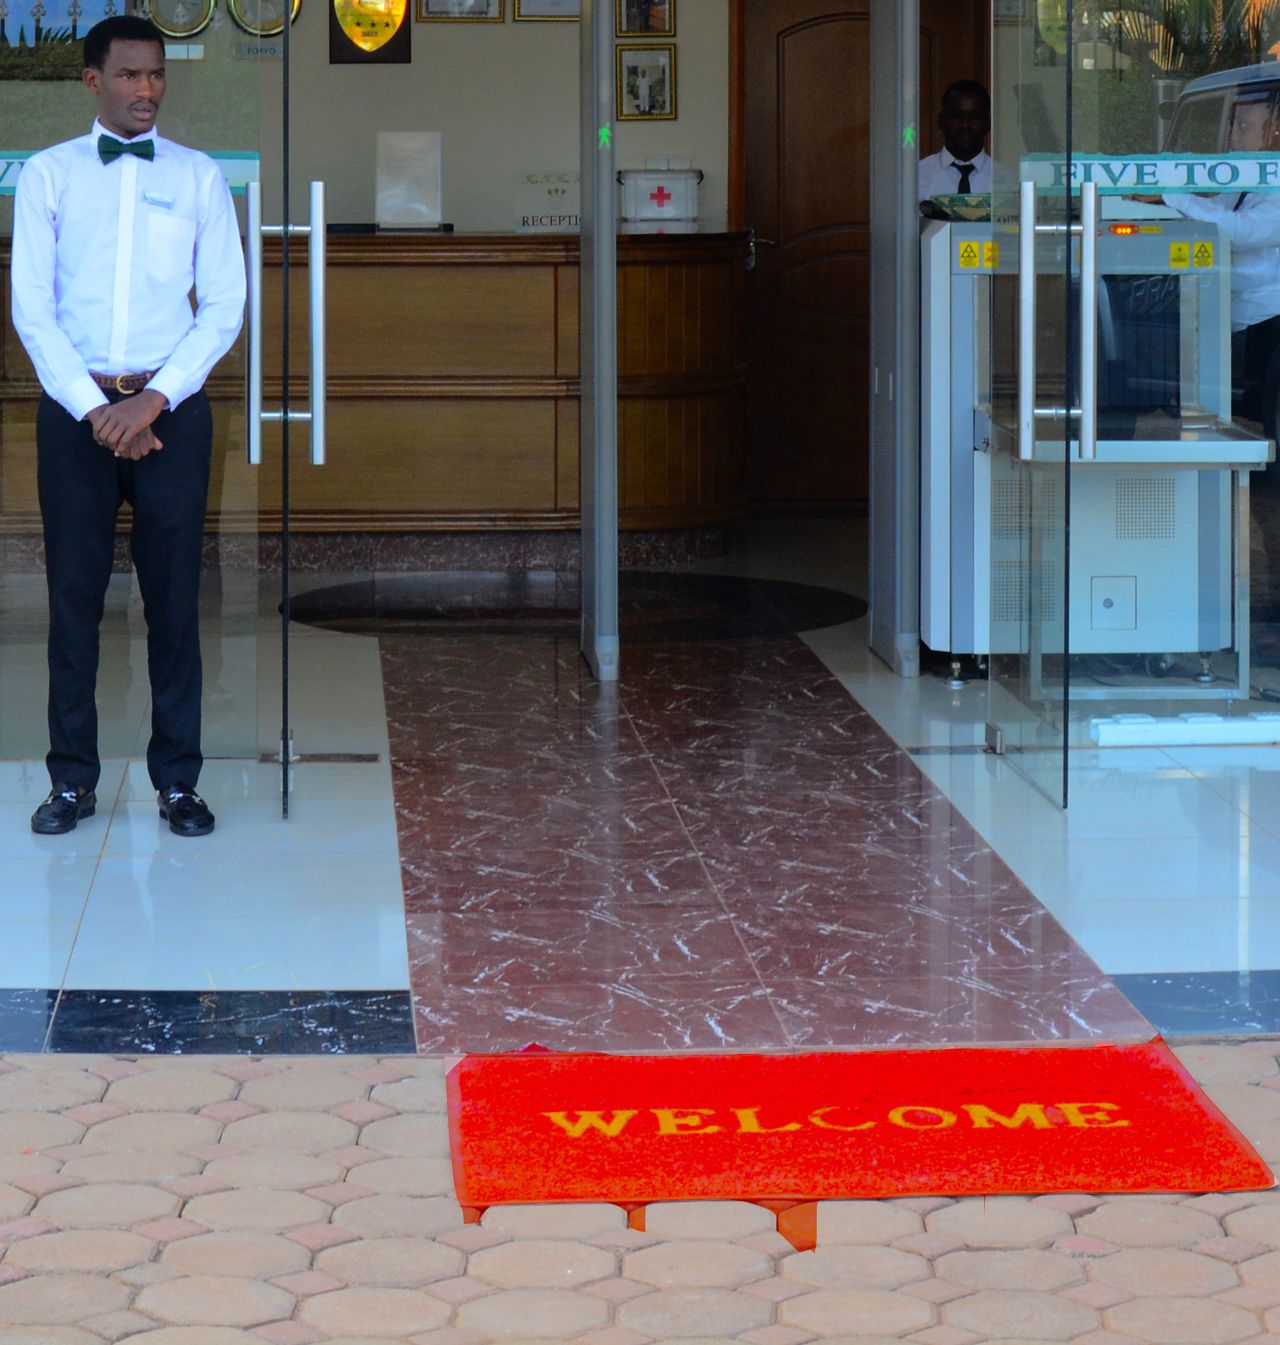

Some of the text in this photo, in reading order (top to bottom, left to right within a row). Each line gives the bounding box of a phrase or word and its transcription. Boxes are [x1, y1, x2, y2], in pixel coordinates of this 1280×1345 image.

[1050, 161, 1160, 187] FIVE
[1175, 161, 1240, 186] TO
[521, 215, 581, 227] RECEPTI
[540, 1102, 1131, 1139] WELCOME
